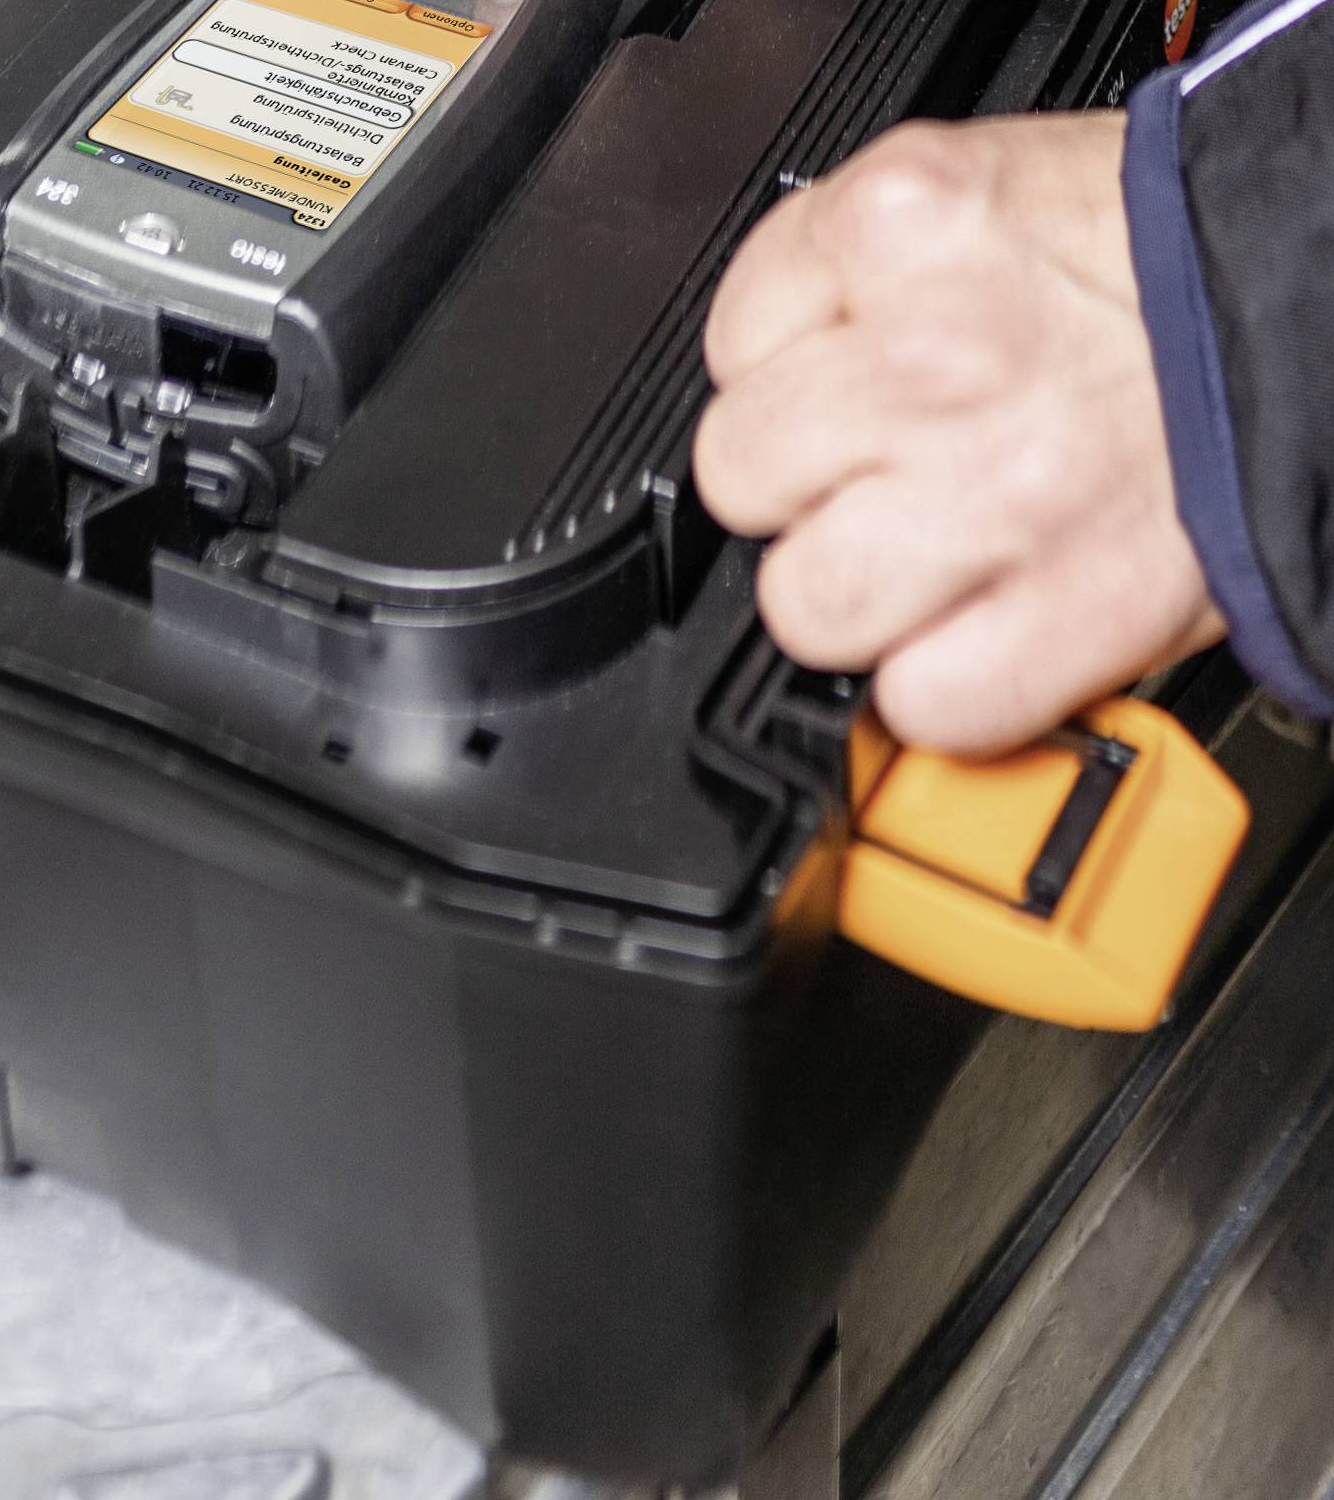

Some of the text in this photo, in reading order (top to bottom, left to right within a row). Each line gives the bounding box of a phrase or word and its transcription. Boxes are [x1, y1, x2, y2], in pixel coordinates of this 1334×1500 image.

[422, 10, 475, 32] Optionen
[331, 40, 439, 80] Caravan Check
[264, 71, 402, 123] Gebrauchsfähigkeit
[327, 71, 416, 107] Kombinierte
[252, 94, 385, 146] Dichtheitsprüfung
[229, 114, 366, 168] Belastungsprüfung
[272, 155, 352, 190] Gasleitung
[225, 172, 334, 214] KUNDE/MESSORT
[298, 211, 326, 228] t324
